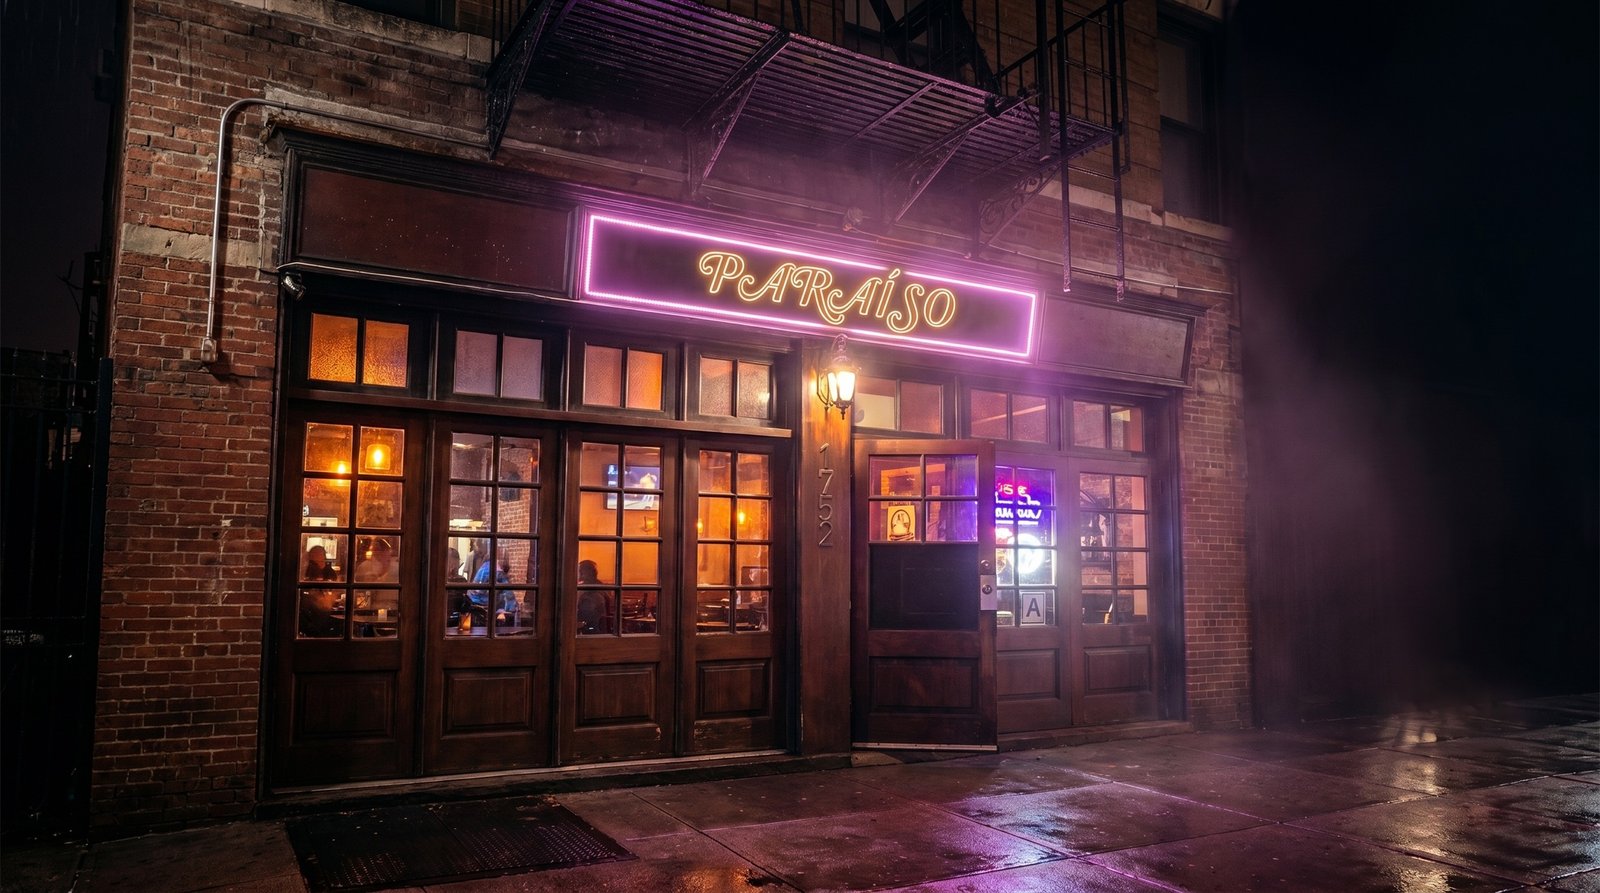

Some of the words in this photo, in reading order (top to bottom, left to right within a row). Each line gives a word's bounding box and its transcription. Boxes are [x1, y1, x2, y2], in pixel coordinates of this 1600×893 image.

[699, 251, 956, 333] PARAÍSO
[818, 443, 834, 547] 1752
[1025, 597, 1041, 618] A
